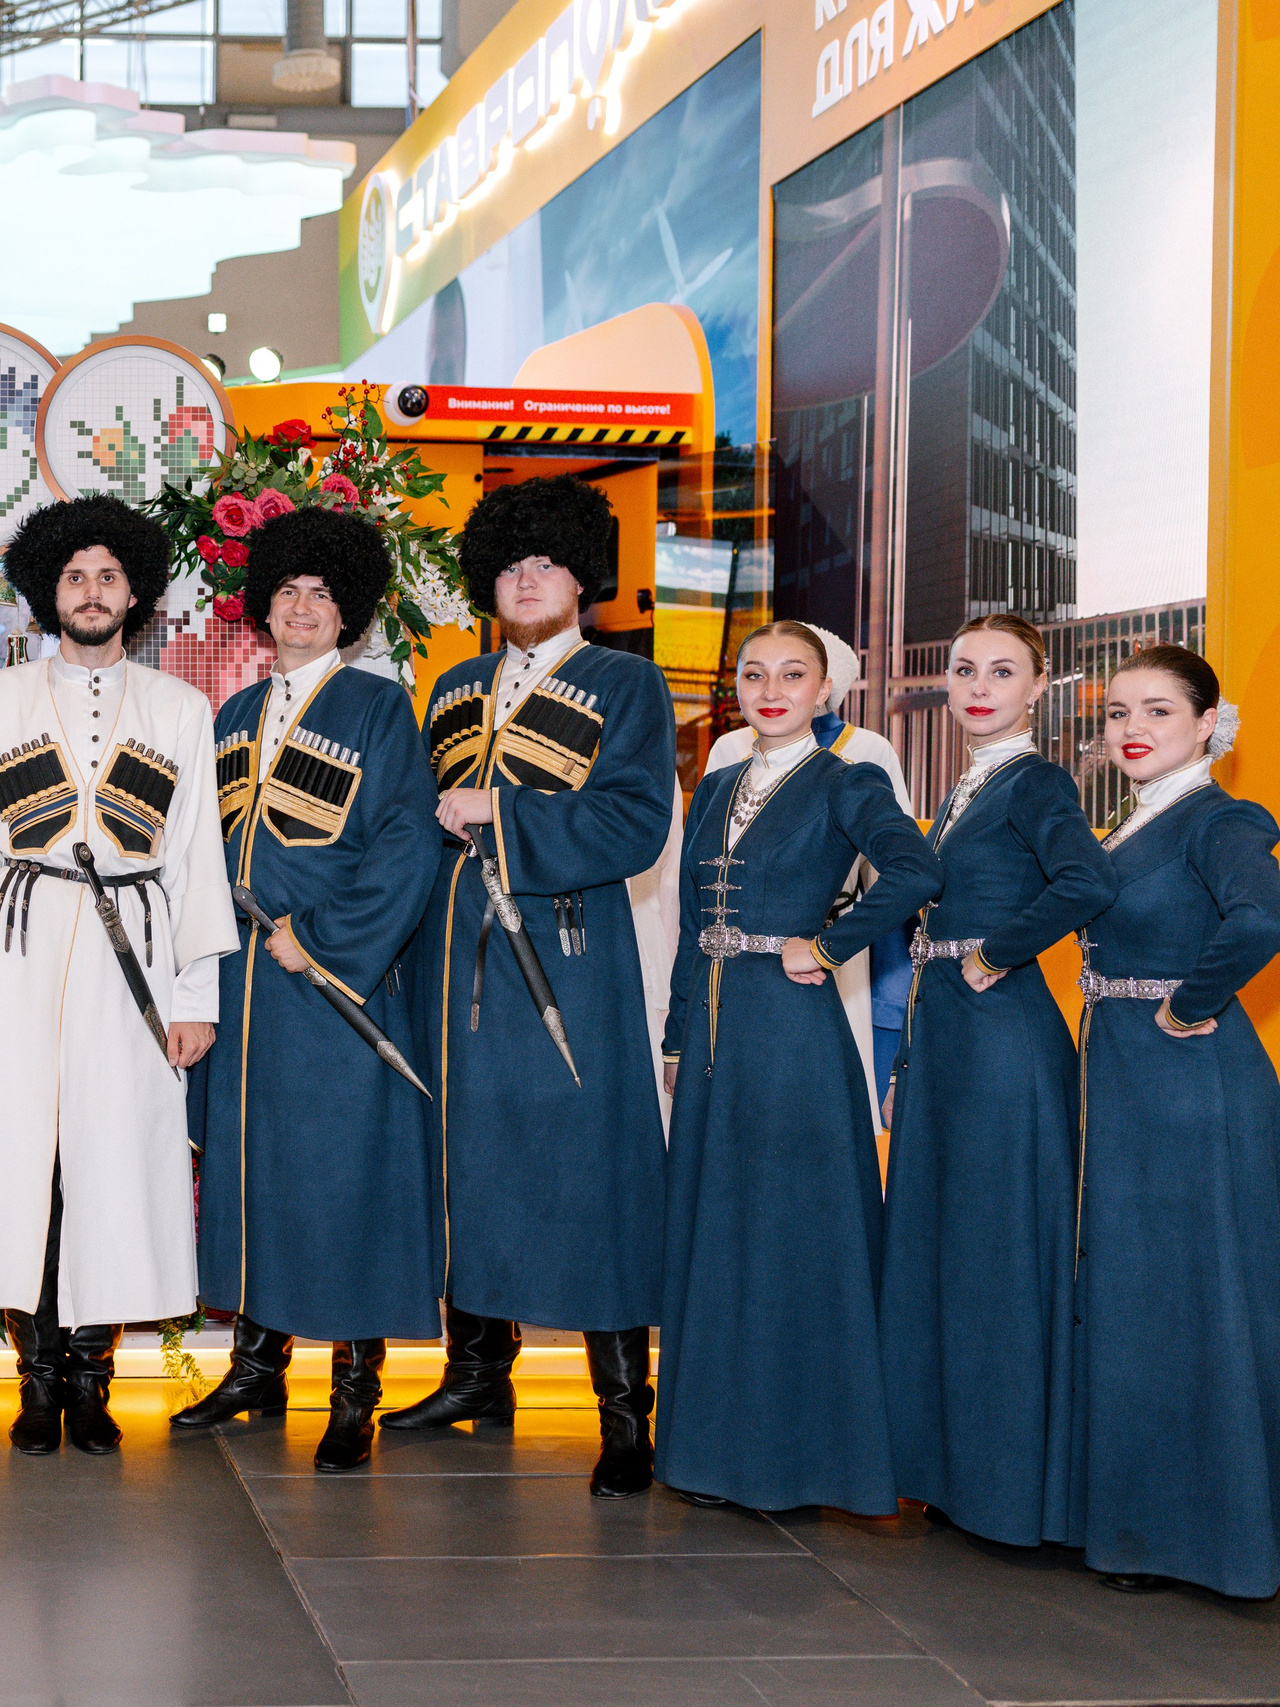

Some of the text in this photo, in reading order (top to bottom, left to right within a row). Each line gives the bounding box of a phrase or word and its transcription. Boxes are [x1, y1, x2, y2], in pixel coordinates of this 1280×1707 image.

[448, 398, 670, 415] Внимание! Ограничение по высоте!
